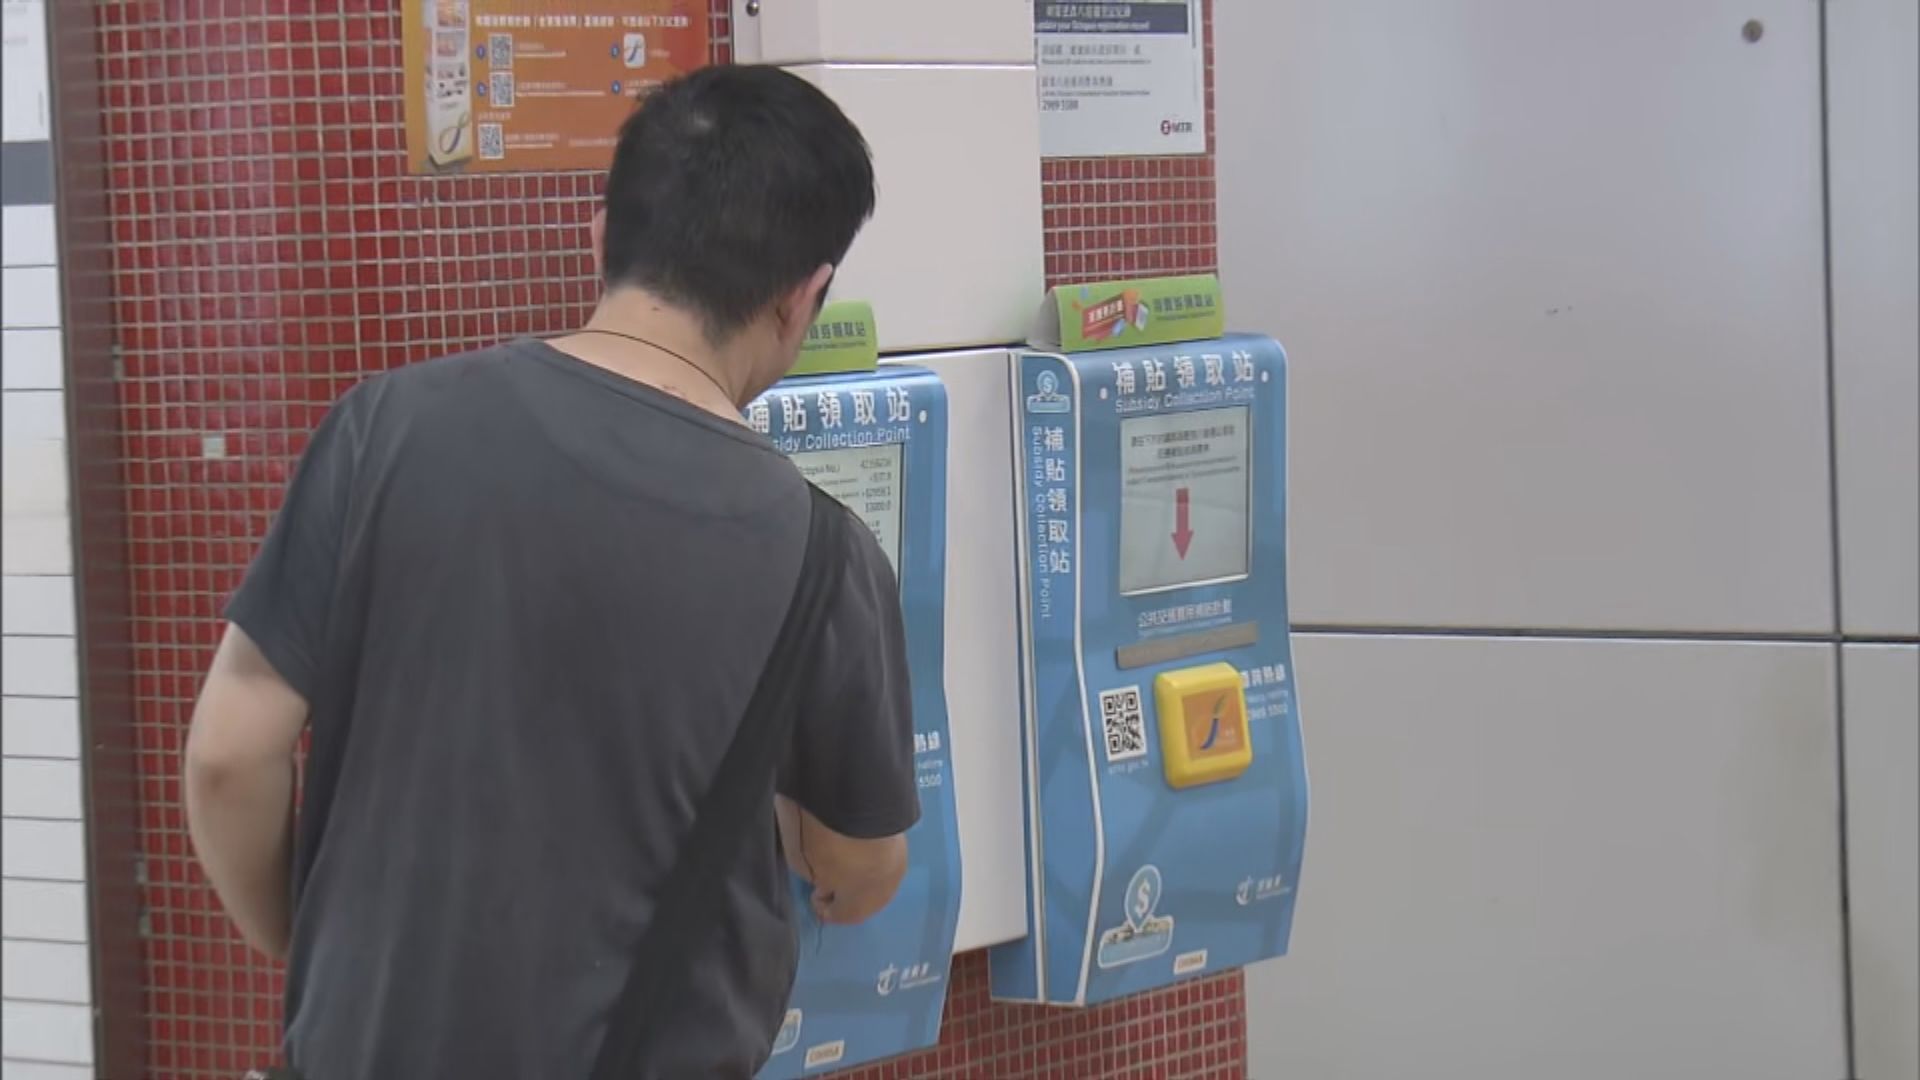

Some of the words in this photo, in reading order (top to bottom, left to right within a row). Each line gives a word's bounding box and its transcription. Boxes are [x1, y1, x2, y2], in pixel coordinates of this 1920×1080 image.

[1173, 122, 1192, 133] MTR
[1111, 350, 1255, 396] 補貼領取站
[1115, 396, 1160, 413] Subsidy
[1163, 389, 1222, 408] Collection
[1225, 386, 1255, 401] Point
[805, 431, 873, 449] Collection
[877, 426, 911, 441] Point
[1032, 425, 1044, 487] Subsidy
[1043, 425, 1071, 575] 補貼領取站
[1035, 494, 1049, 574] Collection
[1039, 578, 1051, 619] Point
